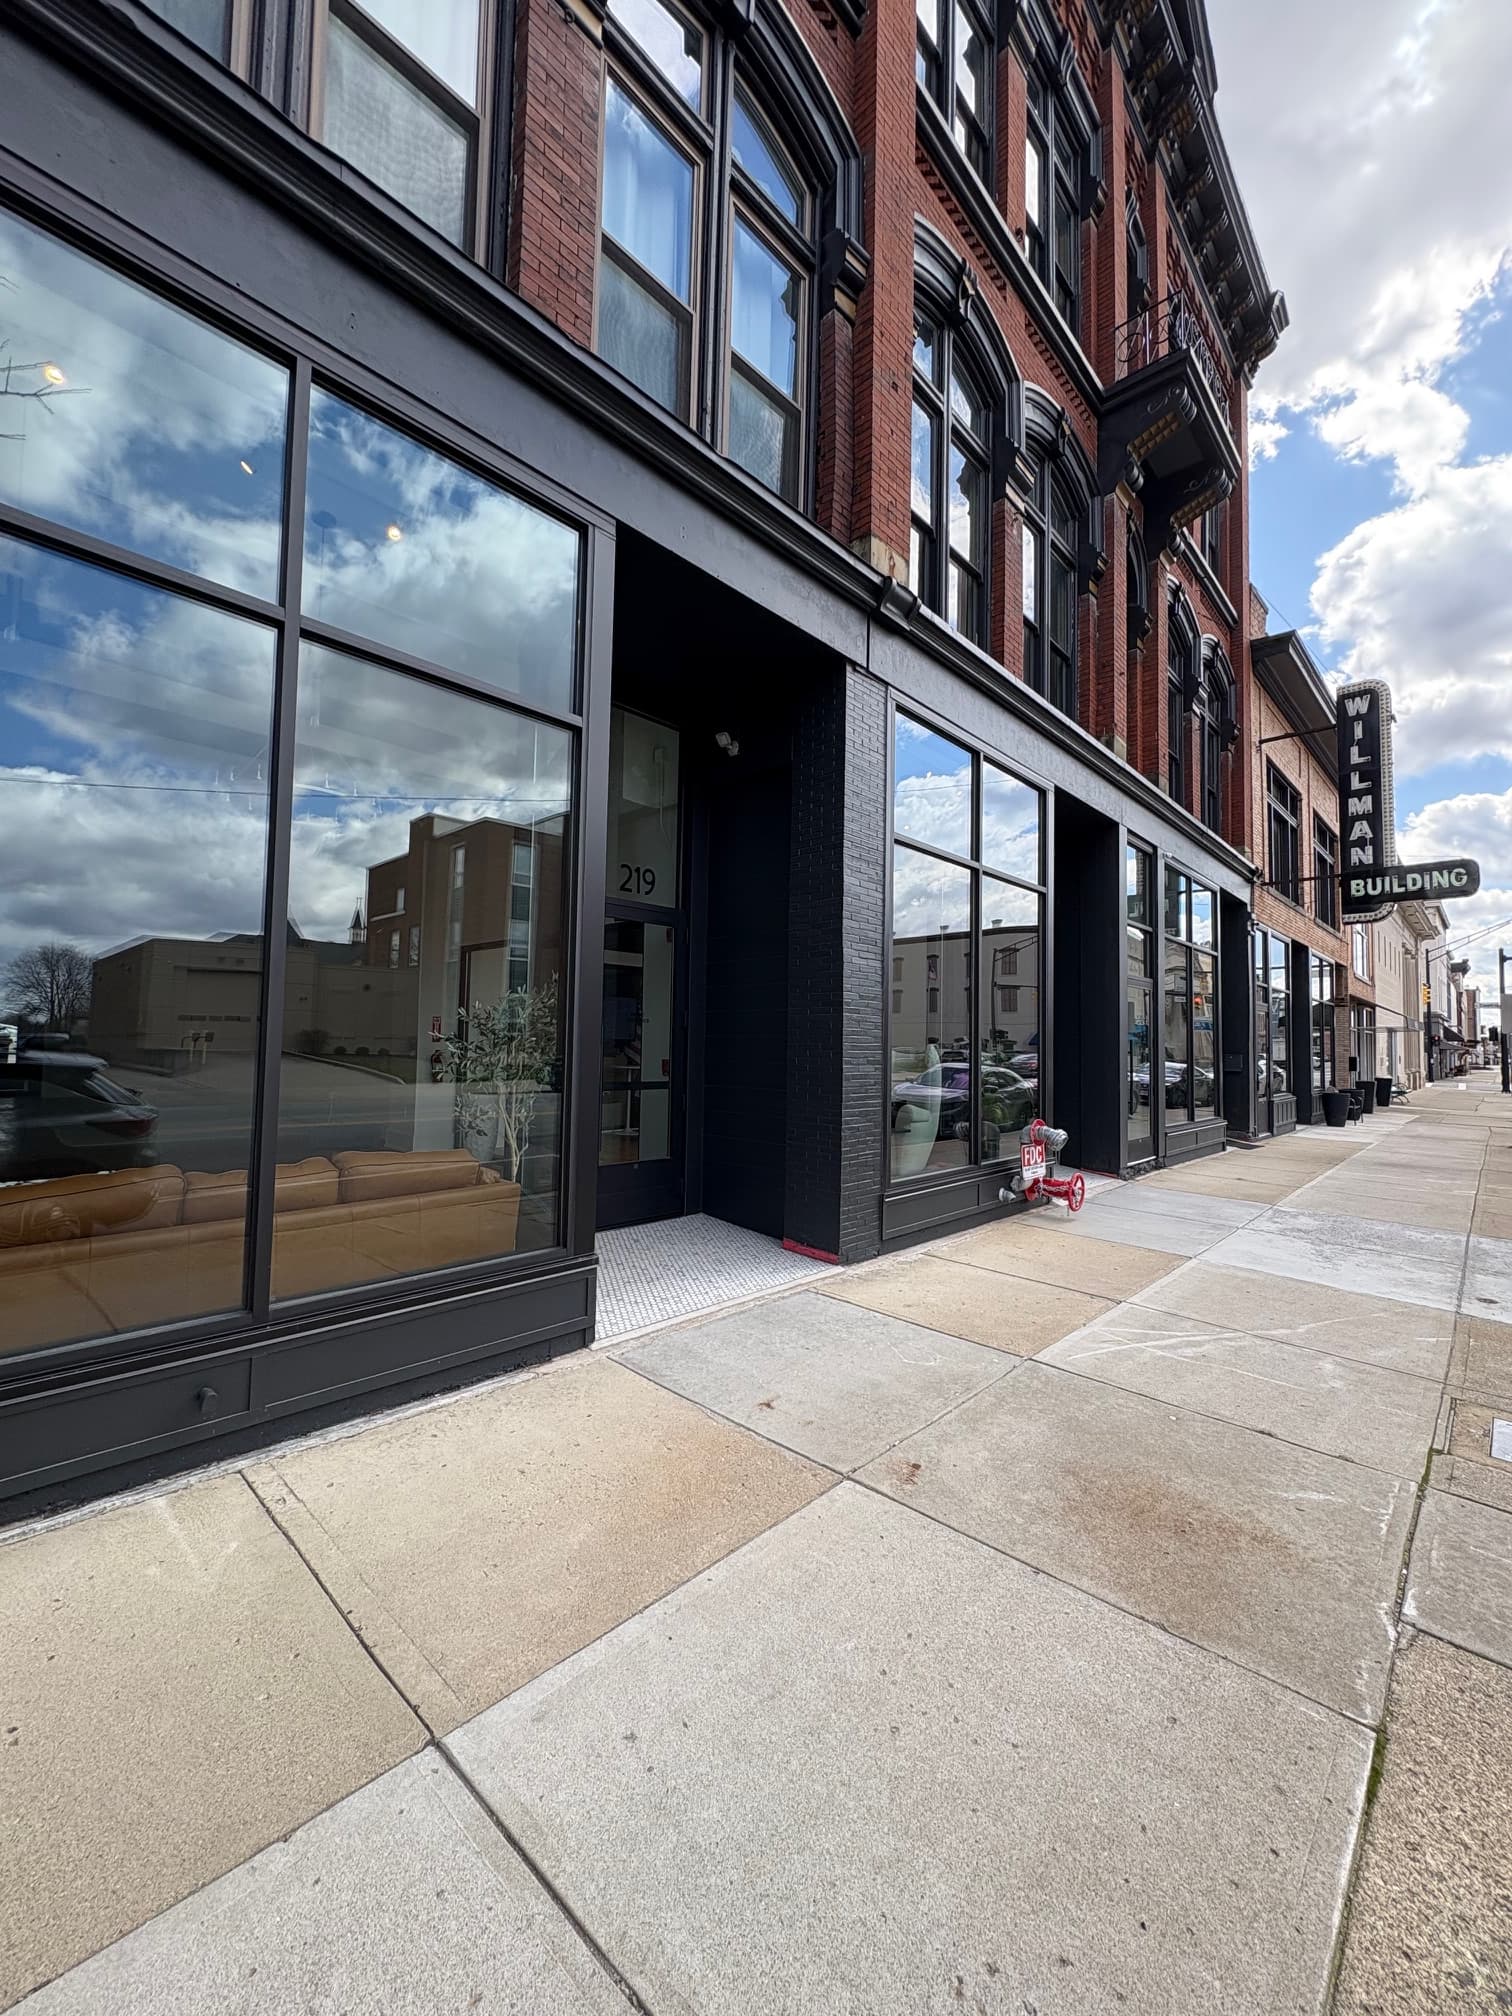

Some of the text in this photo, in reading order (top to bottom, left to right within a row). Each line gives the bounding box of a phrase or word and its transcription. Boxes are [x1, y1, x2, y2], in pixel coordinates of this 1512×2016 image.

[1345, 694, 1373, 866] WILLMAN
[619, 863, 656, 895] 219
[1350, 868, 1468, 897] BUILDING
[1024, 1146, 1042, 1165] FDC
